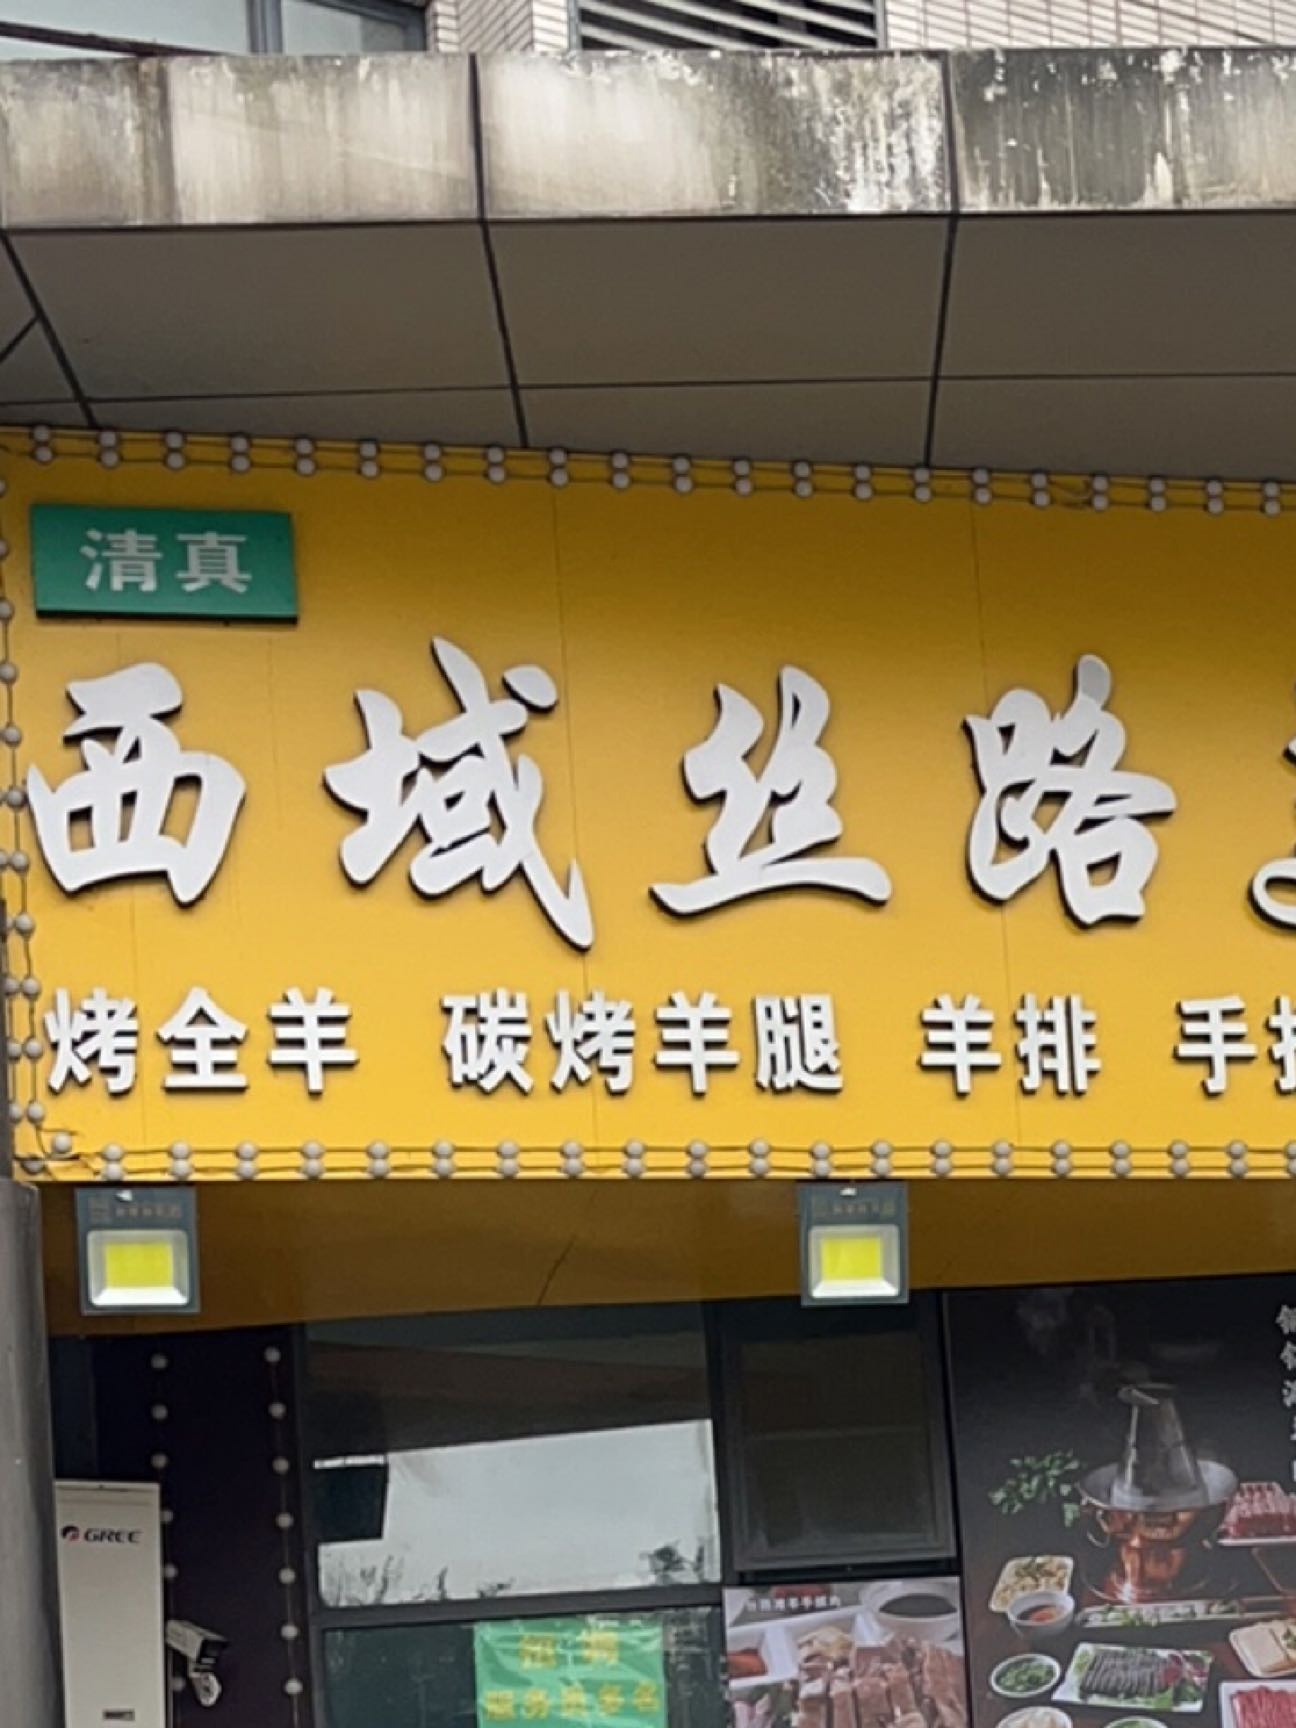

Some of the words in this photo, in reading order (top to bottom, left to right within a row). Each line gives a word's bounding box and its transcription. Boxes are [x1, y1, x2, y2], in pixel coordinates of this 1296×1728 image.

[80, 528, 253, 593] 清真
[43, 986, 359, 1096] 烤全羊
[441, 988, 844, 1096] 碳烤羊腿
[920, 993, 1101, 1096] 羊排
[84, 1527, 144, 1543] GREE
